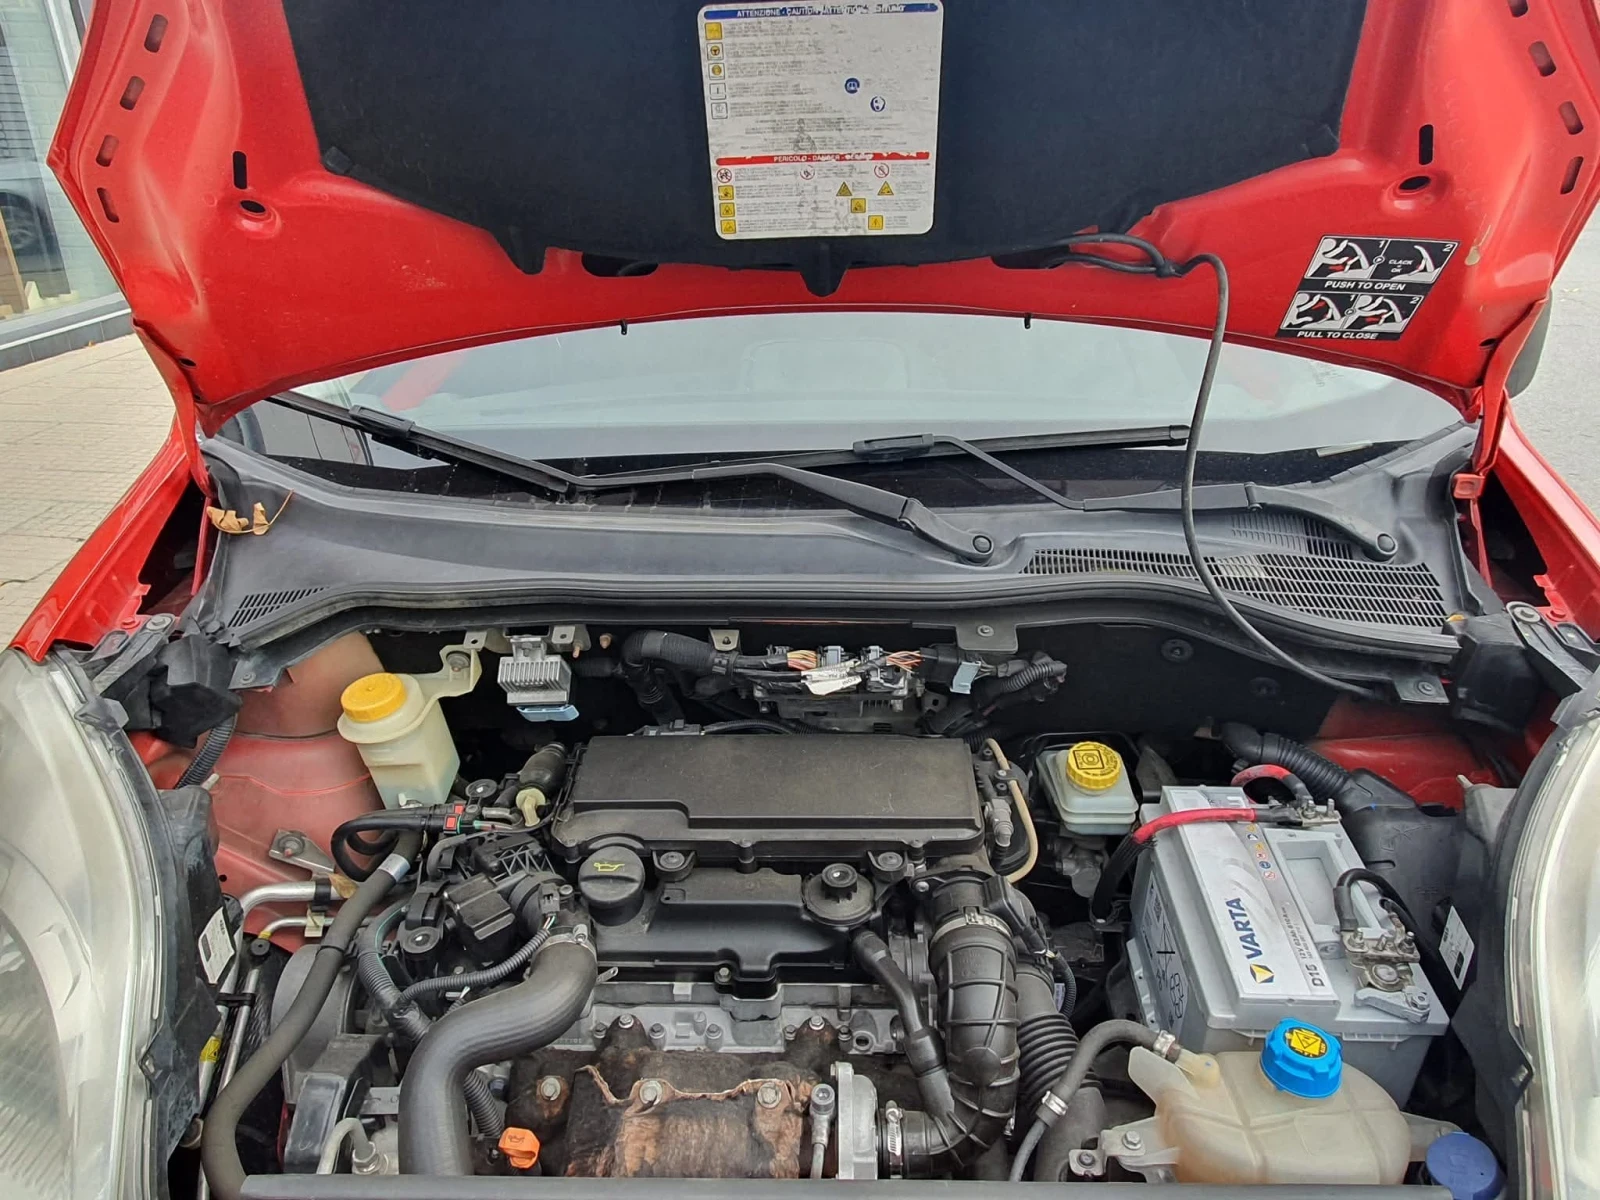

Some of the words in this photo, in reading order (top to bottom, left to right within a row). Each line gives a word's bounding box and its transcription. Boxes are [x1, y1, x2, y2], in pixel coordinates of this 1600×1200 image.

[736, 9, 780, 17] ATTENZIONE
[1442, 244, 1454, 252] 2
[1324, 281, 1355, 290] PUSH
[1357, 281, 1372, 290] TO
[1374, 282, 1406, 291] OPEN
[1342, 332, 1379, 340] CLOSE
[1226, 897, 1263, 960] VARTA
